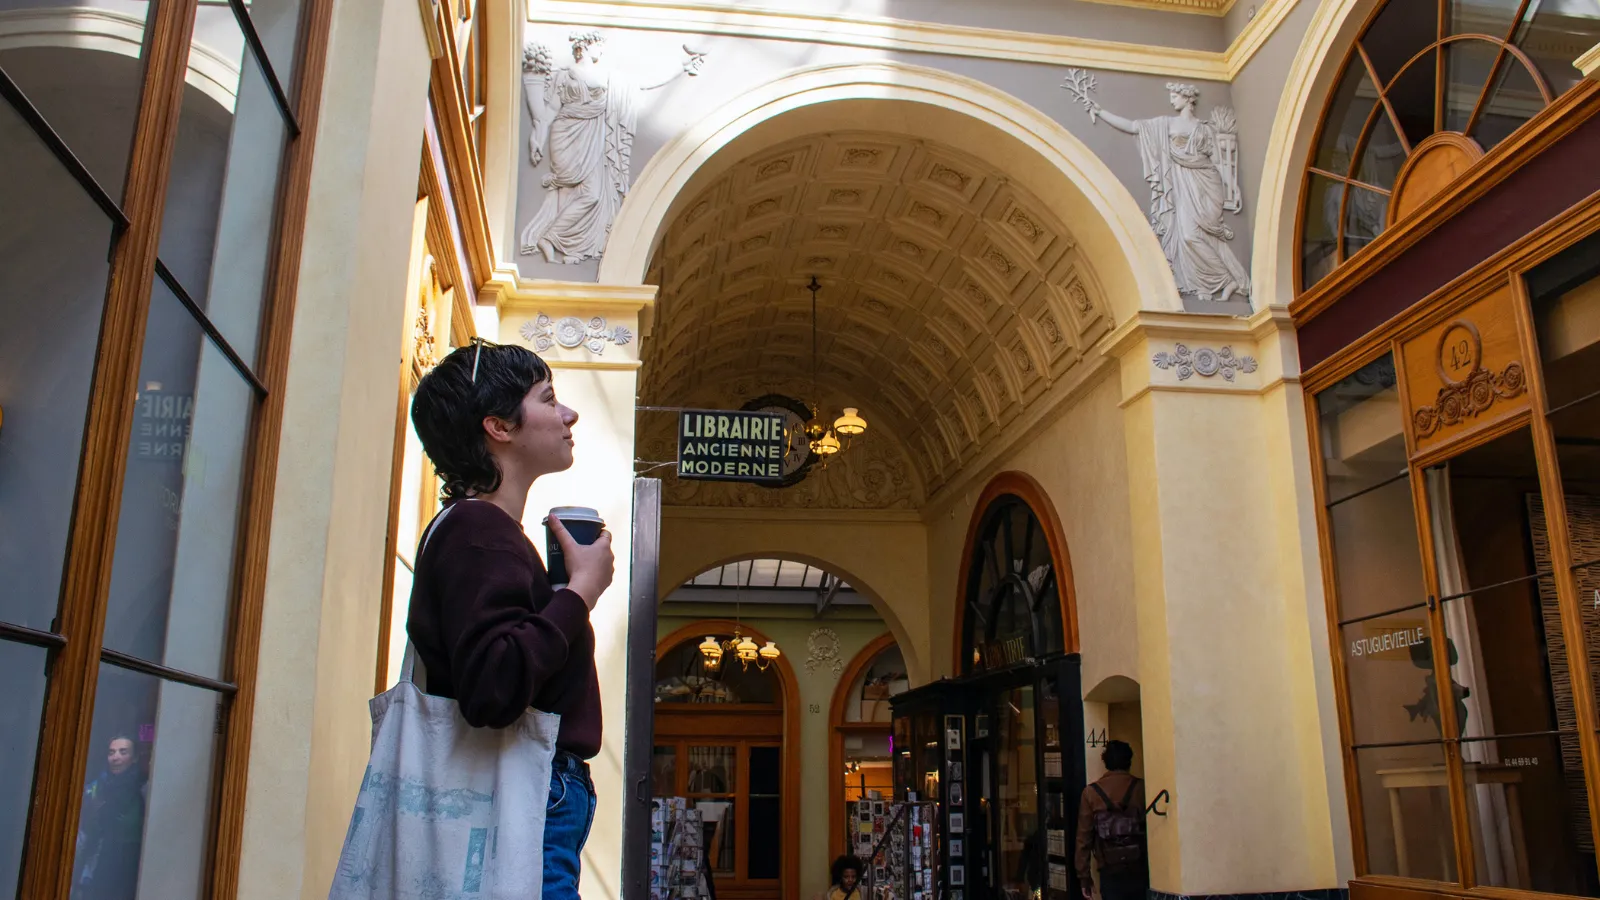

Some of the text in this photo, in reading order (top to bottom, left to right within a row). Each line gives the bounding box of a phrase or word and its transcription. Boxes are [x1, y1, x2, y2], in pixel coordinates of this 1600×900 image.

[1450, 340, 1471, 371] 42
[683, 414, 781, 440] LIBRAIRIE
[683, 442, 780, 459] ANCIENNE
[681, 460, 779, 477] MODERNE
[1351, 627, 1425, 657] ASTUGUEVIEILLE
[809, 704, 820, 714] 52
[1086, 728, 1109, 748] 44
